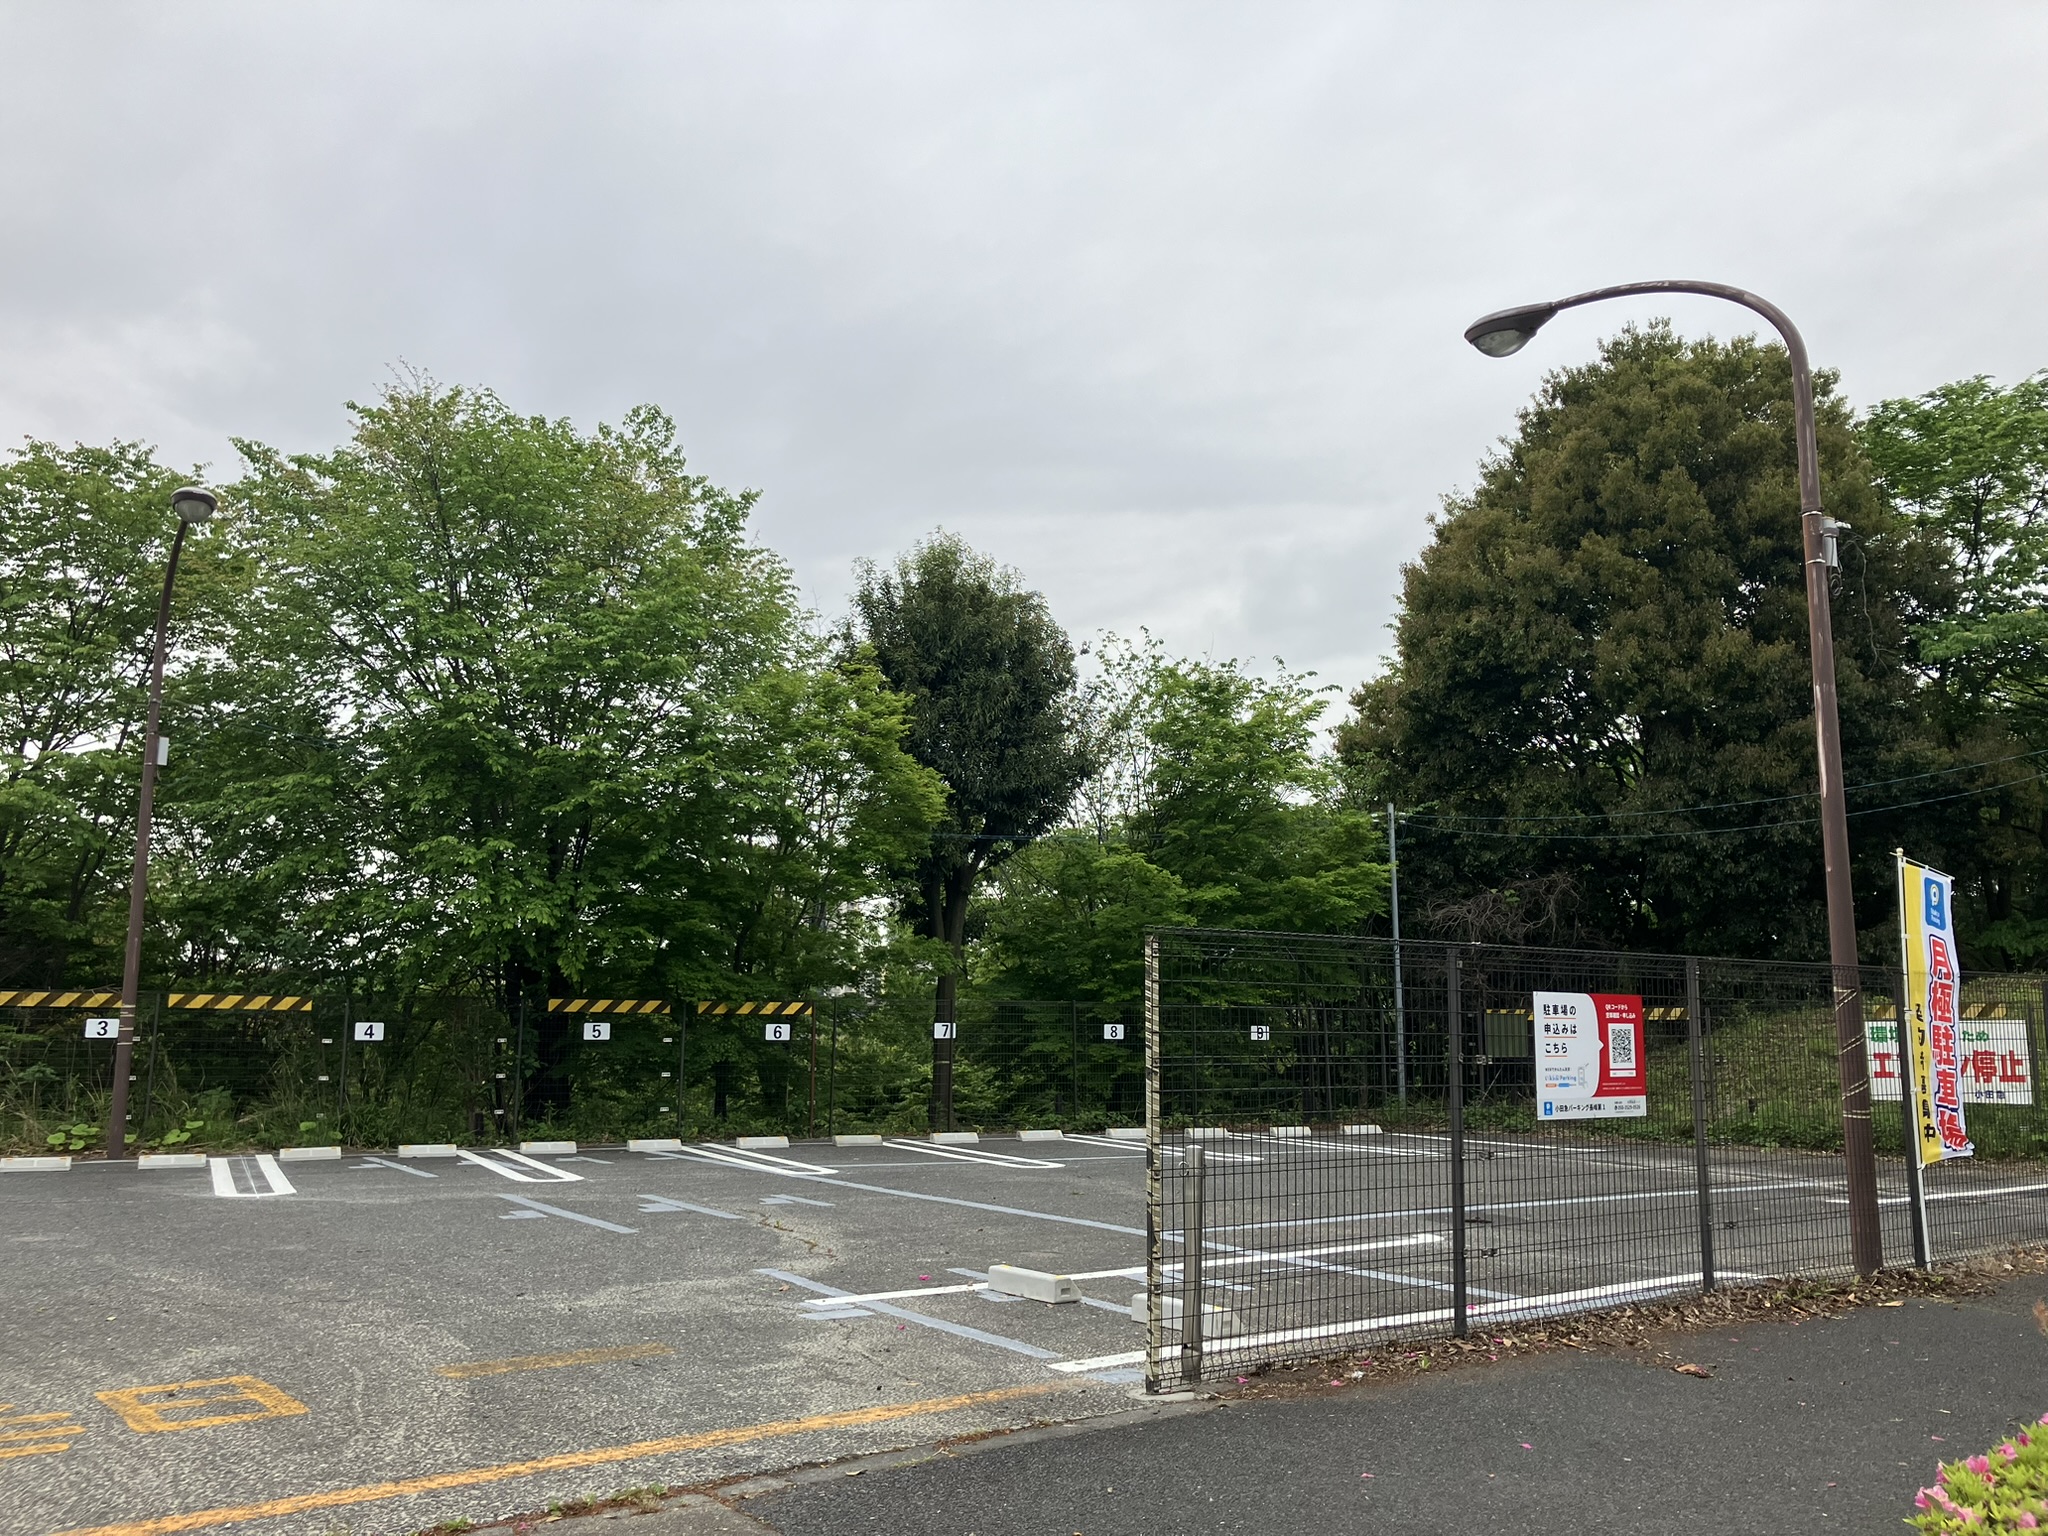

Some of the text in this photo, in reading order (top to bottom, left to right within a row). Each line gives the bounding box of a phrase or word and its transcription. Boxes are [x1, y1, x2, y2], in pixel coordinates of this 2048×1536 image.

[1543, 1004, 1577, 1016] 駐車場の
[96, 1020, 109, 1036] 3
[364, 1024, 375, 1039] 4
[592, 1024, 602, 1039] 5
[773, 1025, 783, 1039] 6
[941, 1024, 949, 1037] 7
[1110, 1025, 1118, 1038] 8
[1257, 1026, 1264, 1040] 9
[1544, 1022, 1577, 1035] 申込みは
[1545, 1042, 1568, 1054] こちら
[1930, 936, 1969, 1150] 月極駐車場
[1872, 1050, 2027, 1083] エ停止
